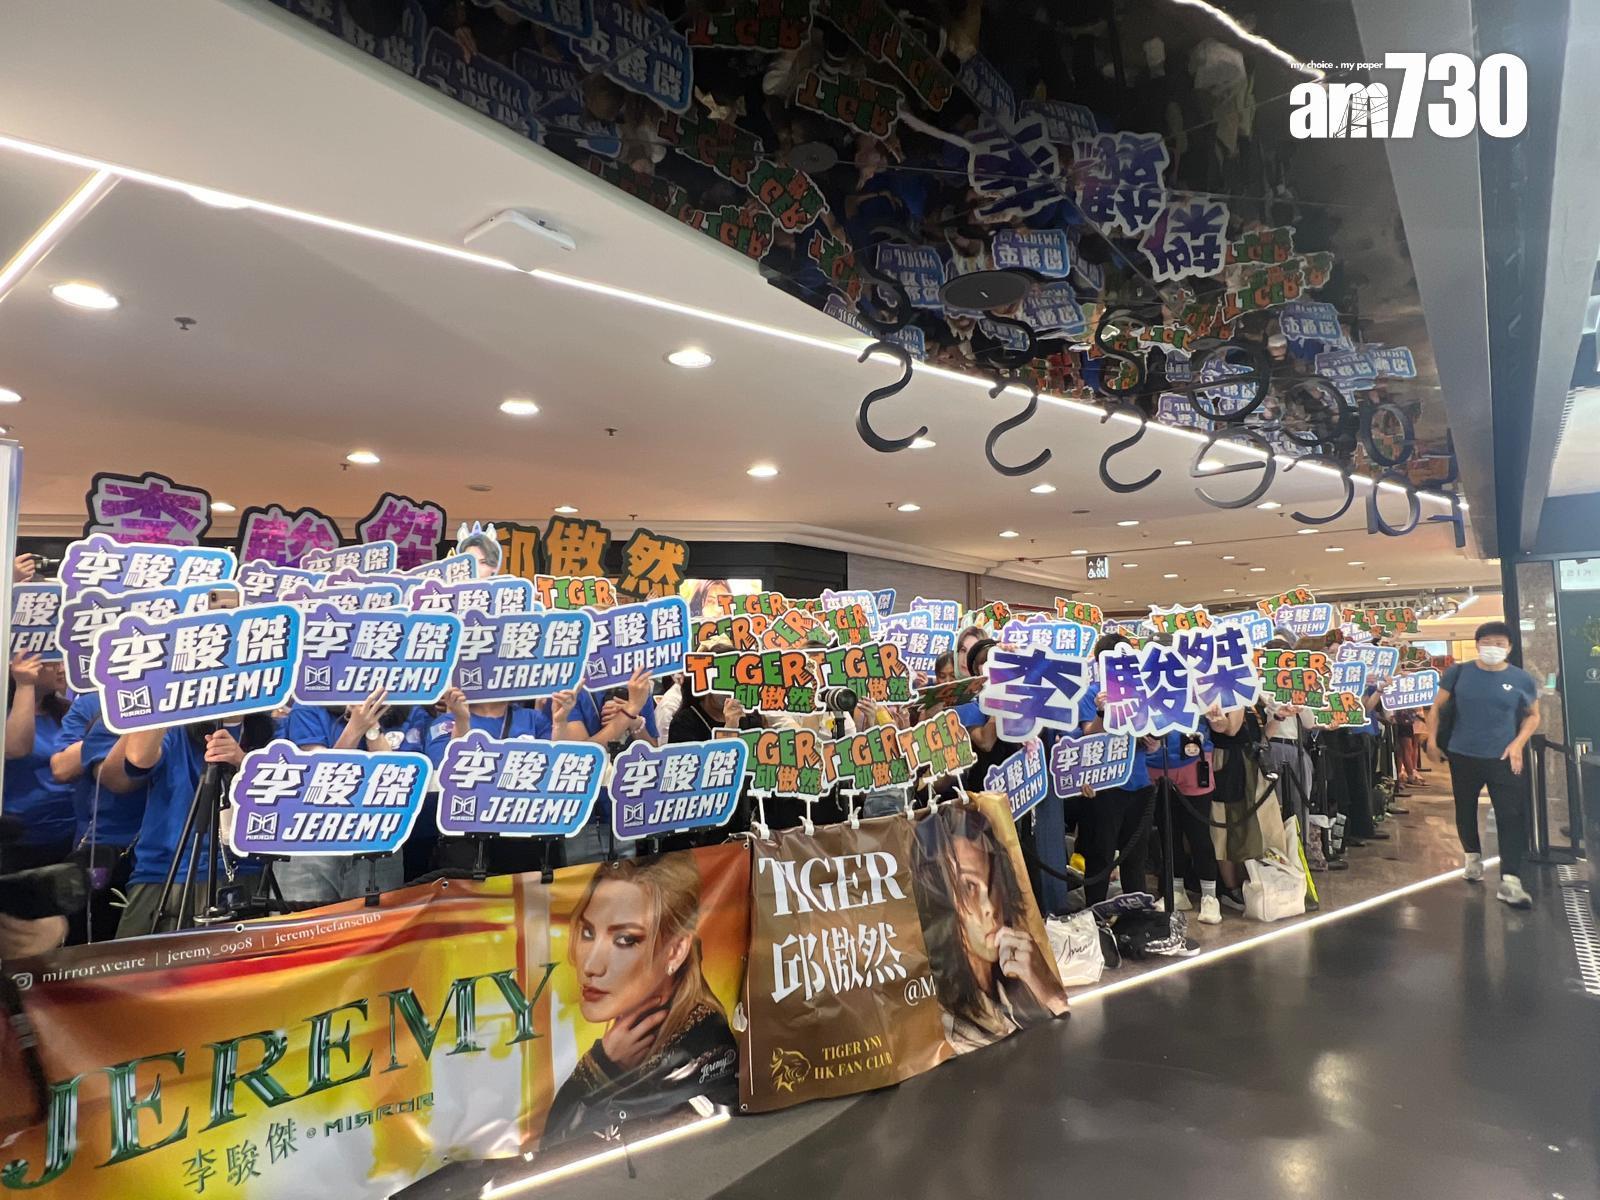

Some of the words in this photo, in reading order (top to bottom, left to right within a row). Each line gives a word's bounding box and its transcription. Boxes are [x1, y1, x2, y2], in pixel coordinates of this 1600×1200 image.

[101, 483, 202, 546] 李
[72, 547, 223, 589] 李駿傑
[621, 533, 685, 597] 然
[537, 578, 613, 609] TIGER
[717, 593, 787, 616] TIGER
[1056, 598, 1101, 624] TIGER
[303, 613, 451, 661] 李駿傑
[460, 618, 583, 661] 李駿傑
[1152, 610, 1212, 634] TIGER
[107, 614, 290, 681] 李駿傑
[612, 642, 683, 676] JEREMY
[806, 643, 906, 689] TIGER
[159, 667, 283, 711] JEREMY
[336, 666, 440, 692] JEREMY
[487, 661, 575, 690] JEREMY
[686, 651, 813, 692] TIGER
[984, 649, 1083, 737] 李
[1104, 647, 1196, 731] 駿
[822, 727, 902, 783] TIGER
[898, 711, 967, 770] TIGER
[1056, 735, 1129, 772] 李駿傑
[246, 754, 415, 806] 李駿傑
[449, 742, 593, 792] 李駿傑
[620, 749, 738, 797] 李駿傑
[1076, 763, 1127, 788] JEREMY
[480, 796, 581, 824] JEREMY
[648, 792, 729, 824] JEREMY
[1010, 775, 1043, 813] JEREMY
[282, 812, 402, 841] JEREMY
[759, 851, 907, 916] TIGER
[42, 958, 146, 982] mirror.weare
[165, 937, 254, 965] jeremy_0908
[274, 913, 382, 946] jeremyleefansclub
[771, 922, 907, 1003] 邱傲然
[822, 1040, 862, 1061] TIGER
[838, 1060, 863, 1077] FAN
[866, 1052, 893, 1070] CLUB
[1, 962, 560, 1190] JEREMY
[182, 1118, 299, 1194] 李駿傑
